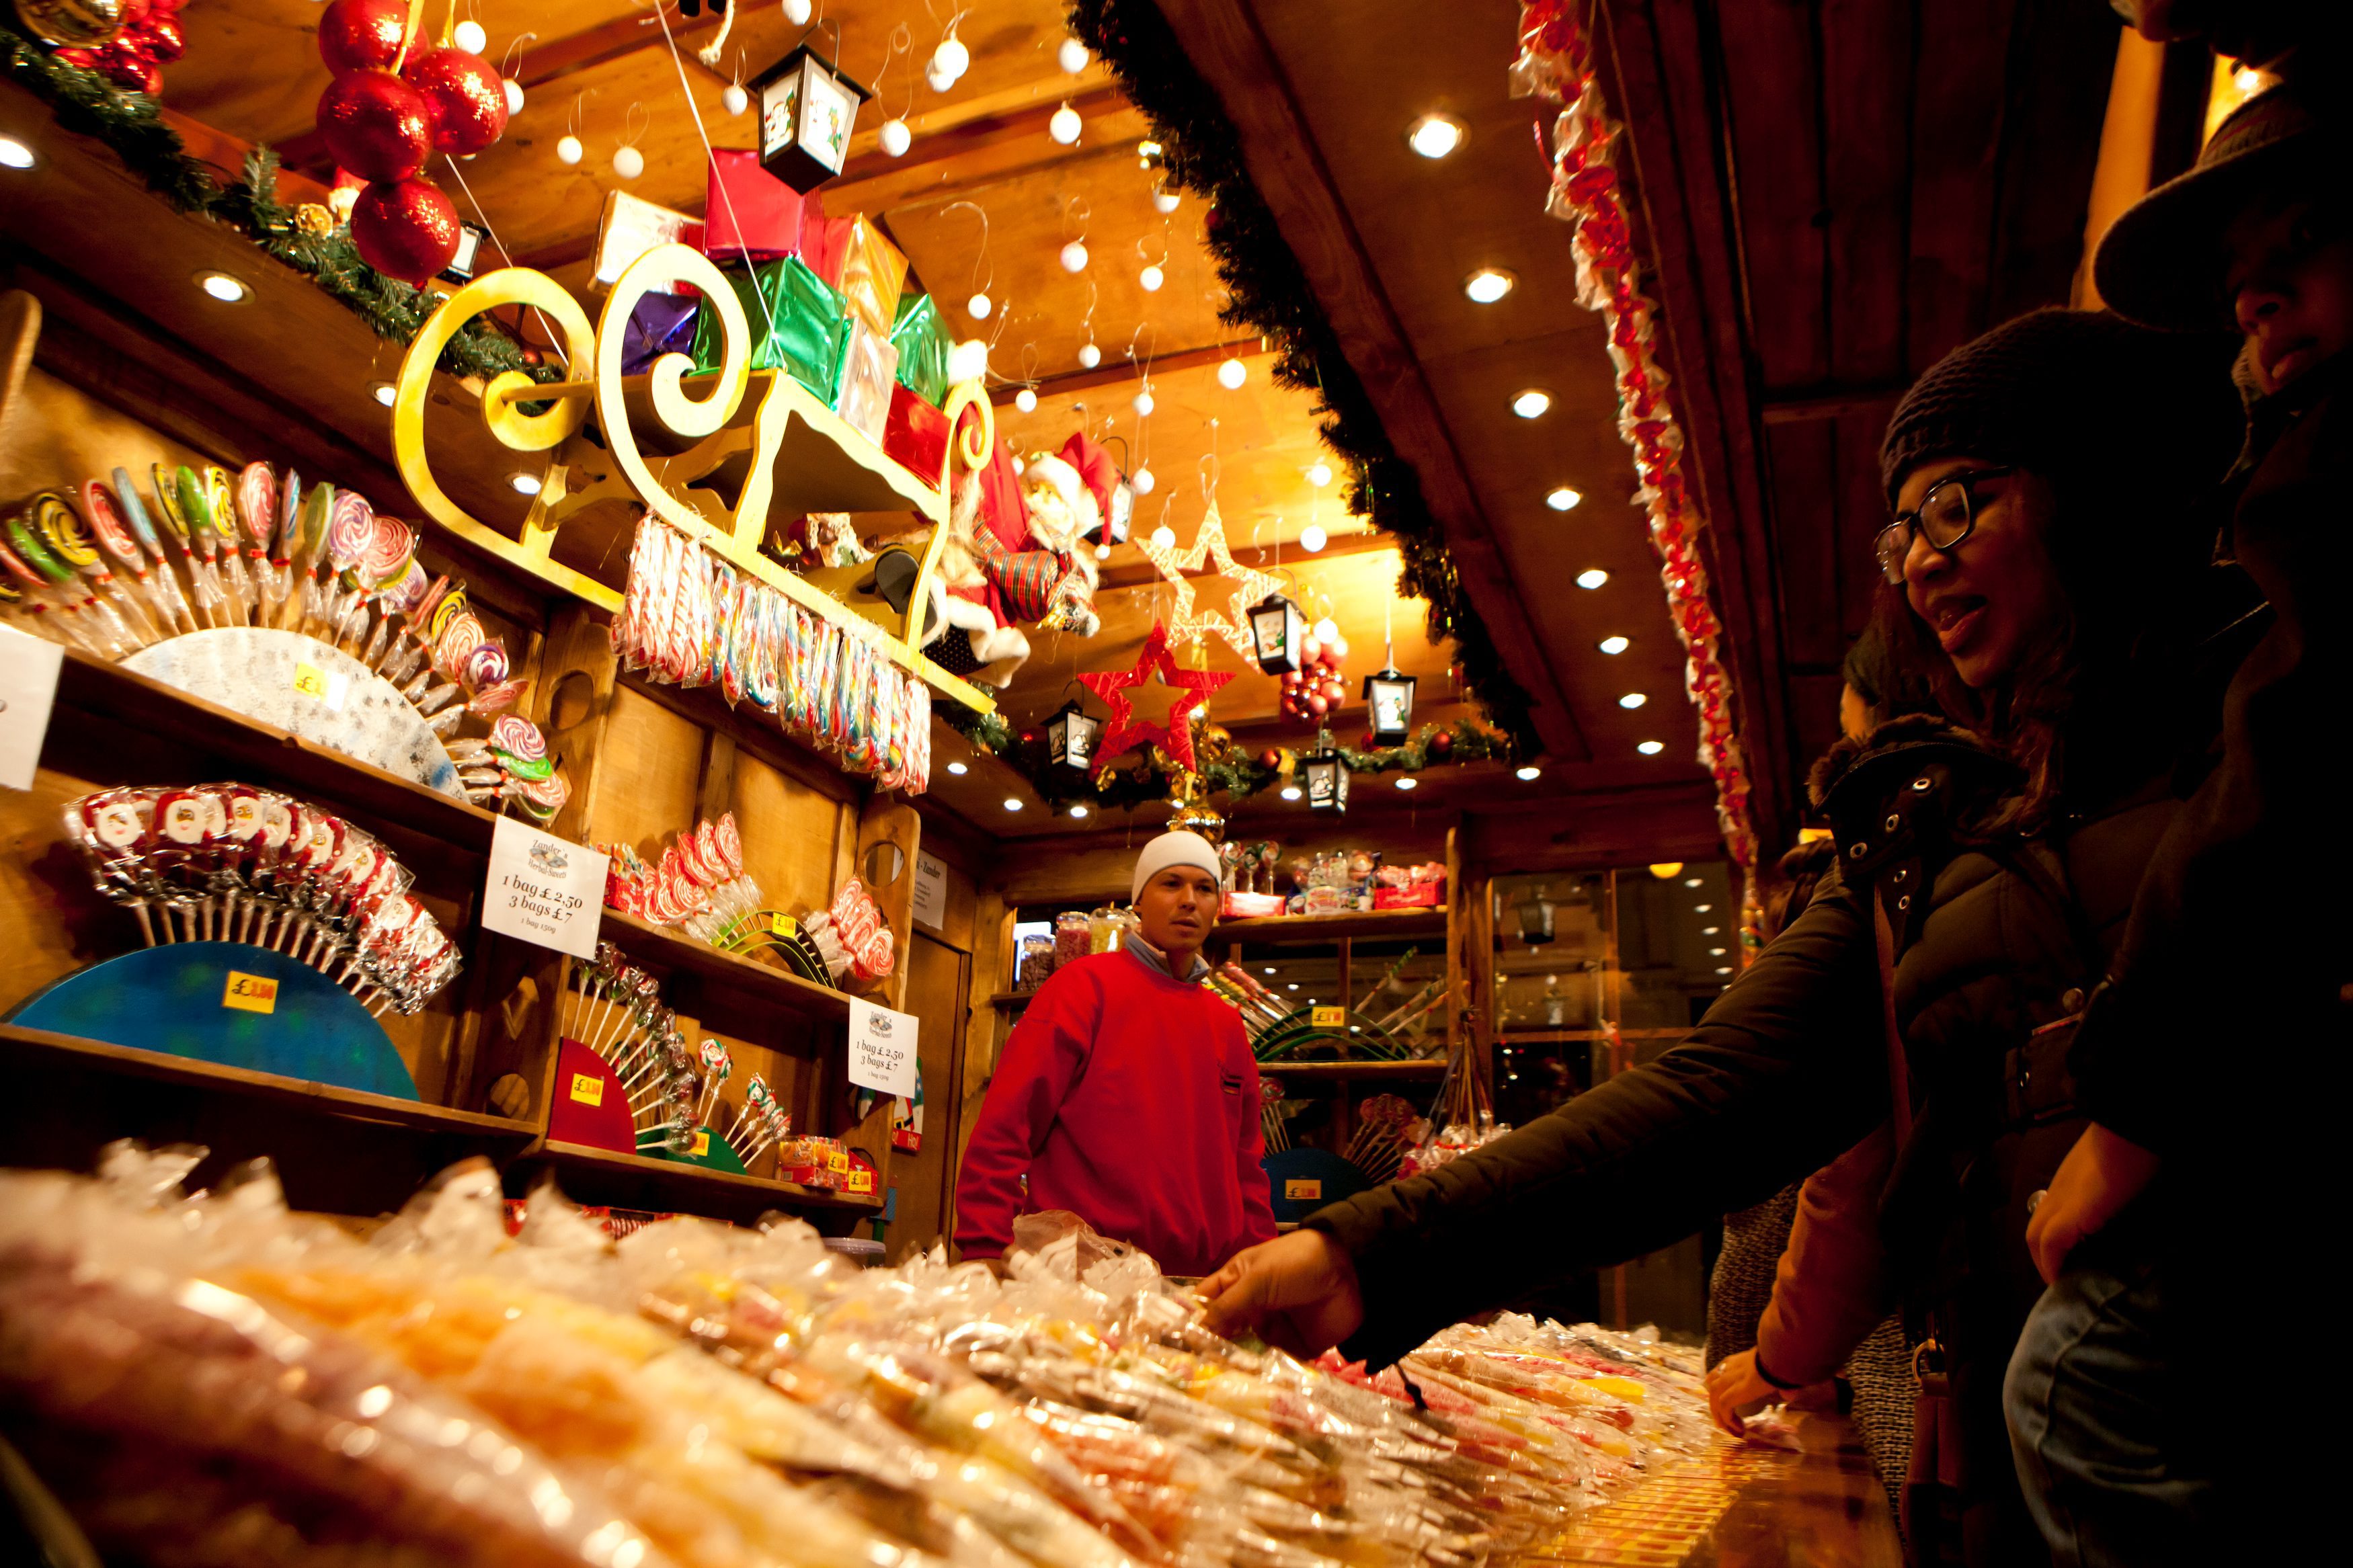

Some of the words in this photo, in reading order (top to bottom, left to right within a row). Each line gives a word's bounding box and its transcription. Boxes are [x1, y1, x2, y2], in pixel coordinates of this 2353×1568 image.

[502, 876, 509, 885] 1
[513, 875, 539, 898] bag
[509, 895, 518, 908] 3
[521, 895, 551, 916] bags
[526, 917, 539, 930] bag
[541, 923, 557, 934] 150g
[856, 1041, 859, 1049] 1
[862, 1039, 877, 1055] bag
[861, 1056, 866, 1065] 3
[867, 1056, 884, 1069] bags
